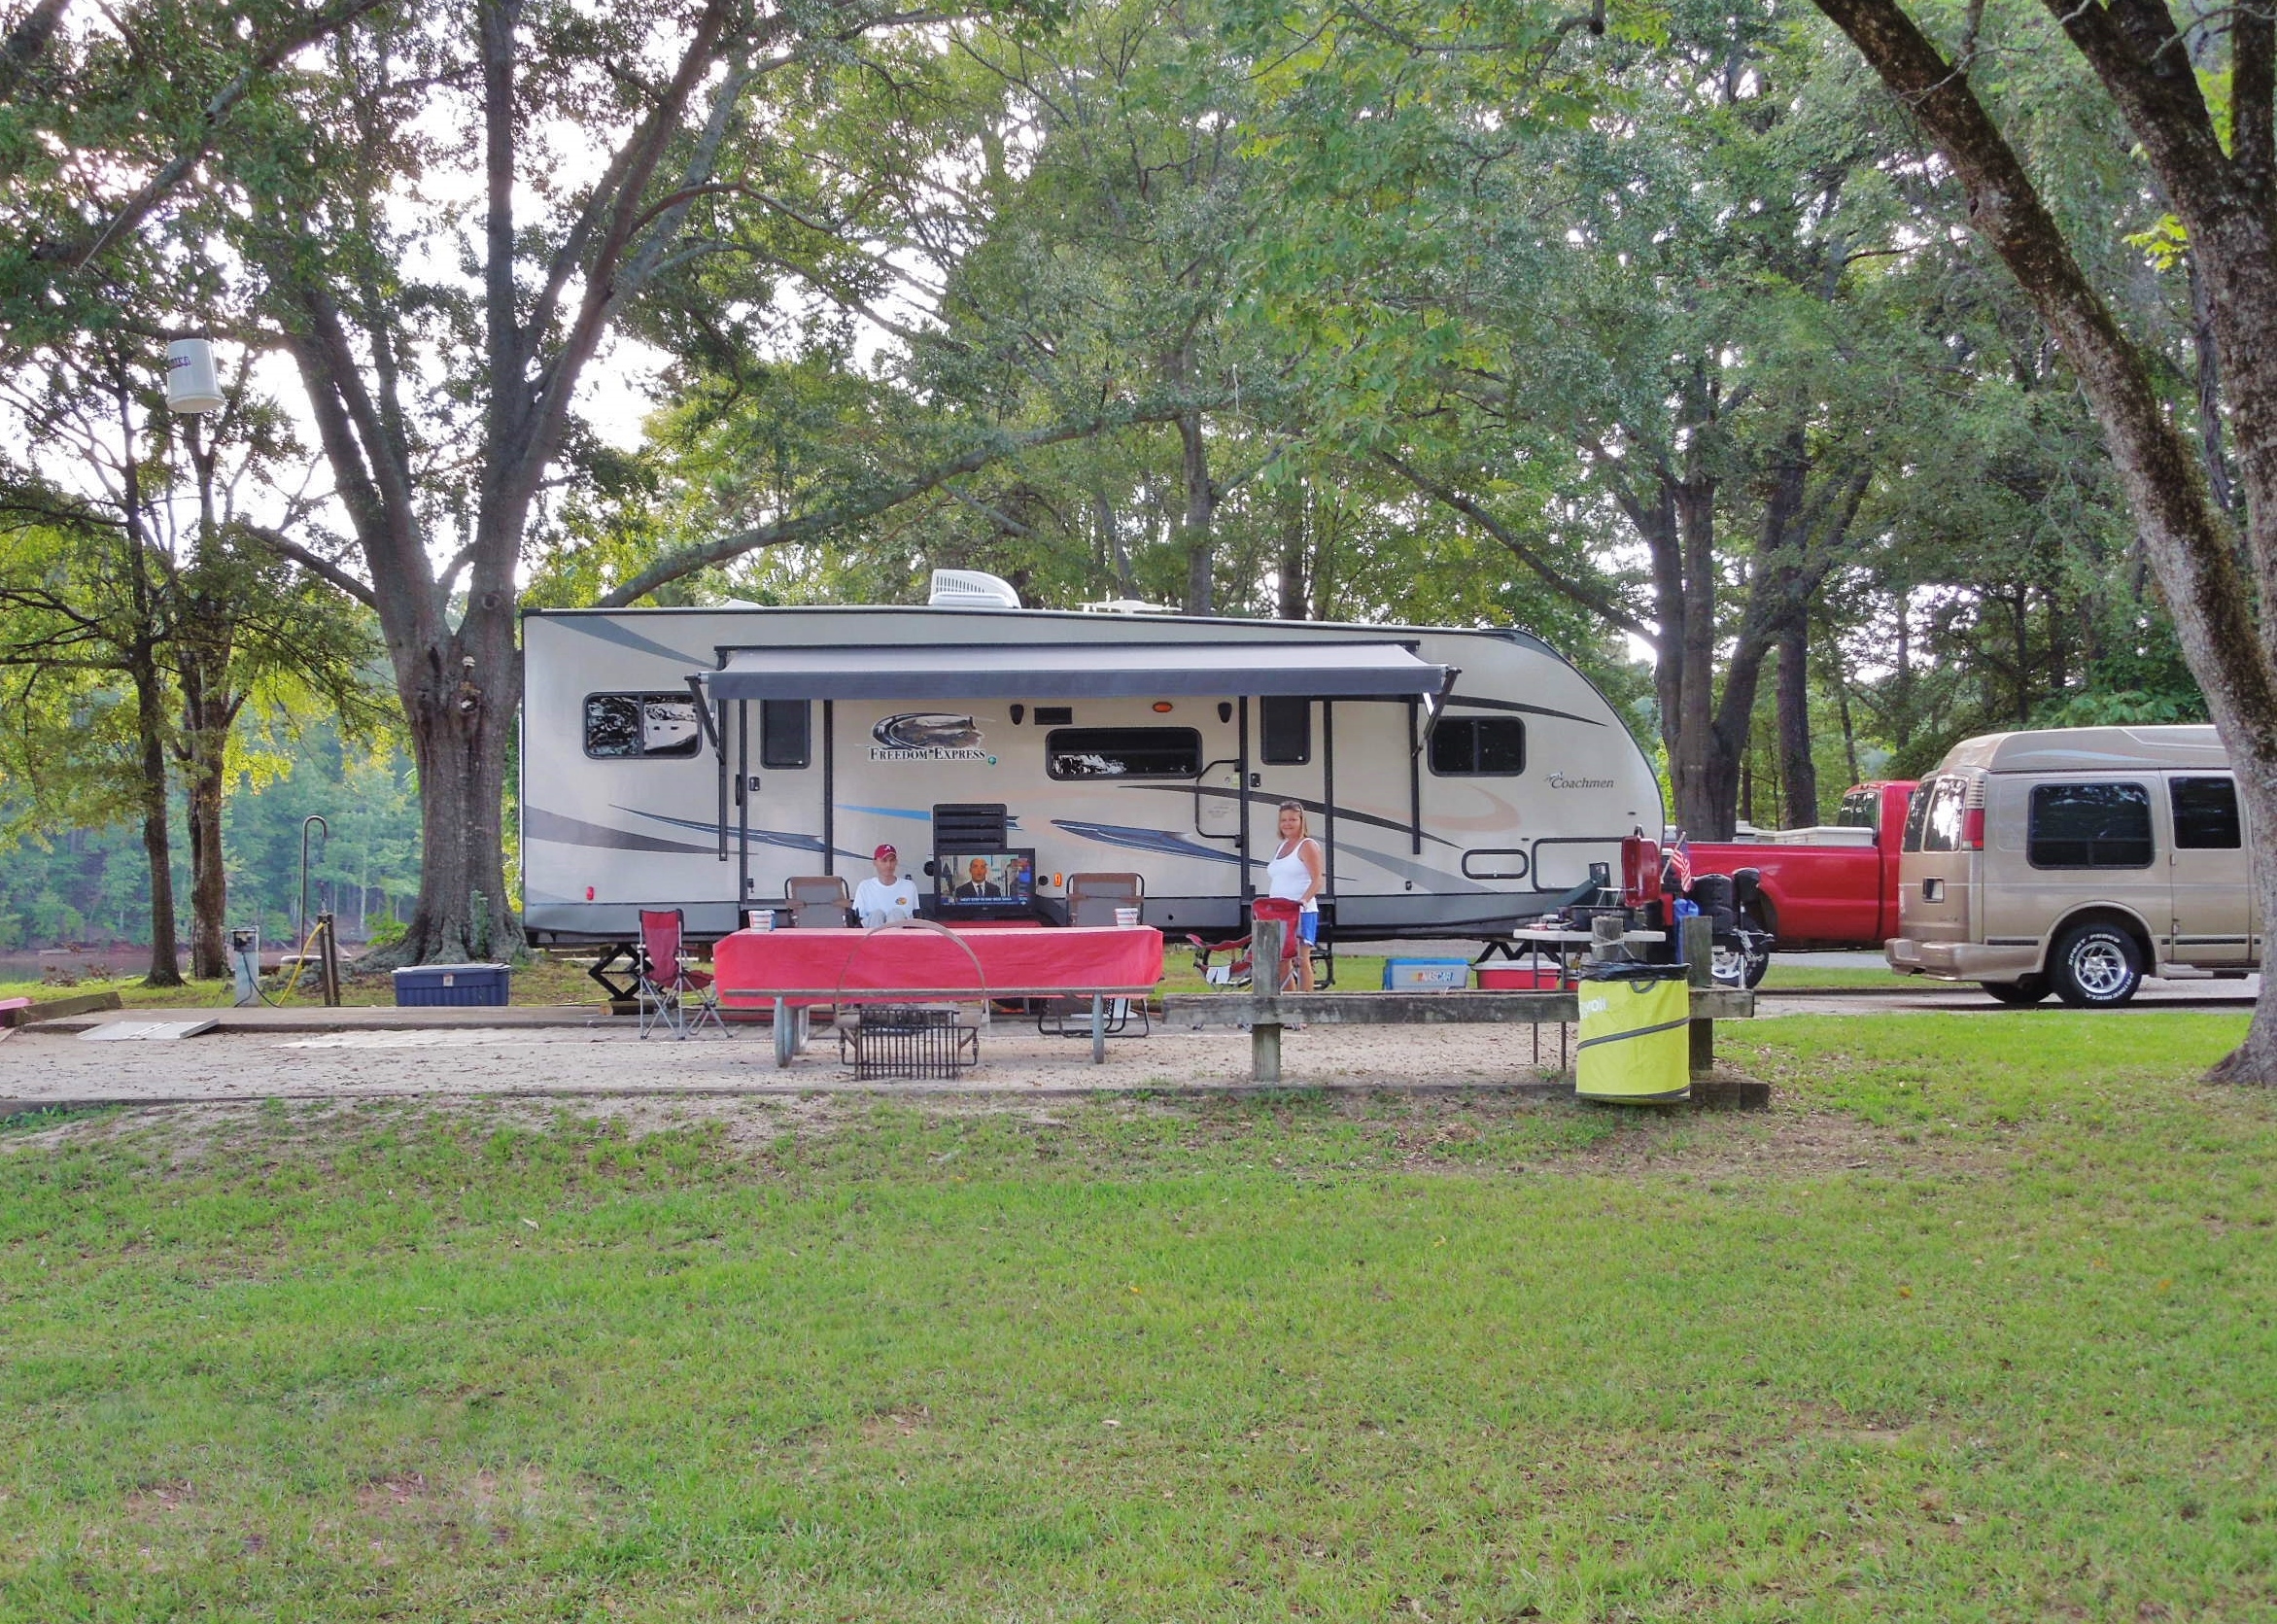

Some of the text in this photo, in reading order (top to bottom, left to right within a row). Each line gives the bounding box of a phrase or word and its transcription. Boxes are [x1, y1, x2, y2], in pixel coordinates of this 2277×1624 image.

[870, 746, 986, 760] FREEDOM EXPRESS
[1550, 777, 1614, 789] Coachmen
